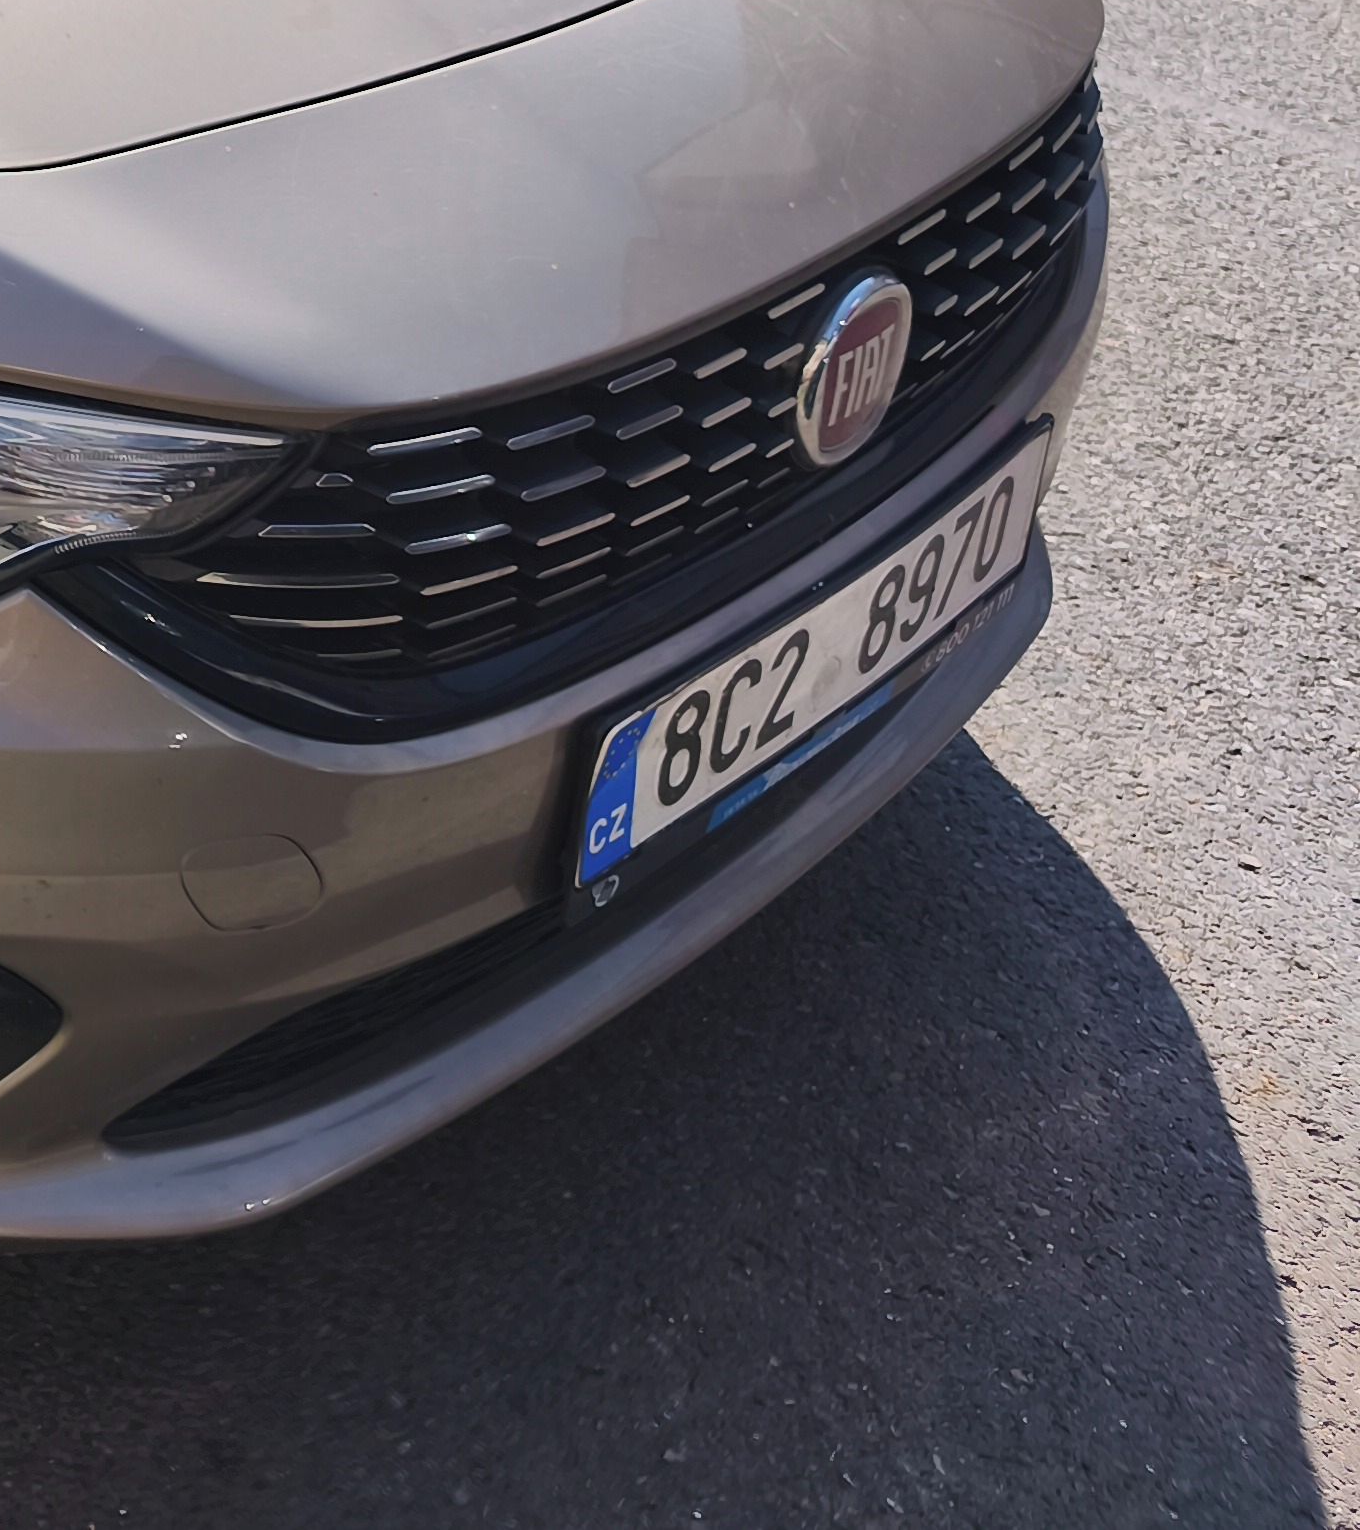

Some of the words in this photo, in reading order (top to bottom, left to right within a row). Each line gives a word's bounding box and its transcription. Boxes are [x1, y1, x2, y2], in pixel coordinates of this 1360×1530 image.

[828, 323, 895, 427] FIAT
[657, 628, 810, 807] 8C2
[858, 475, 1015, 675] 8970
[588, 802, 628, 855] CZ
